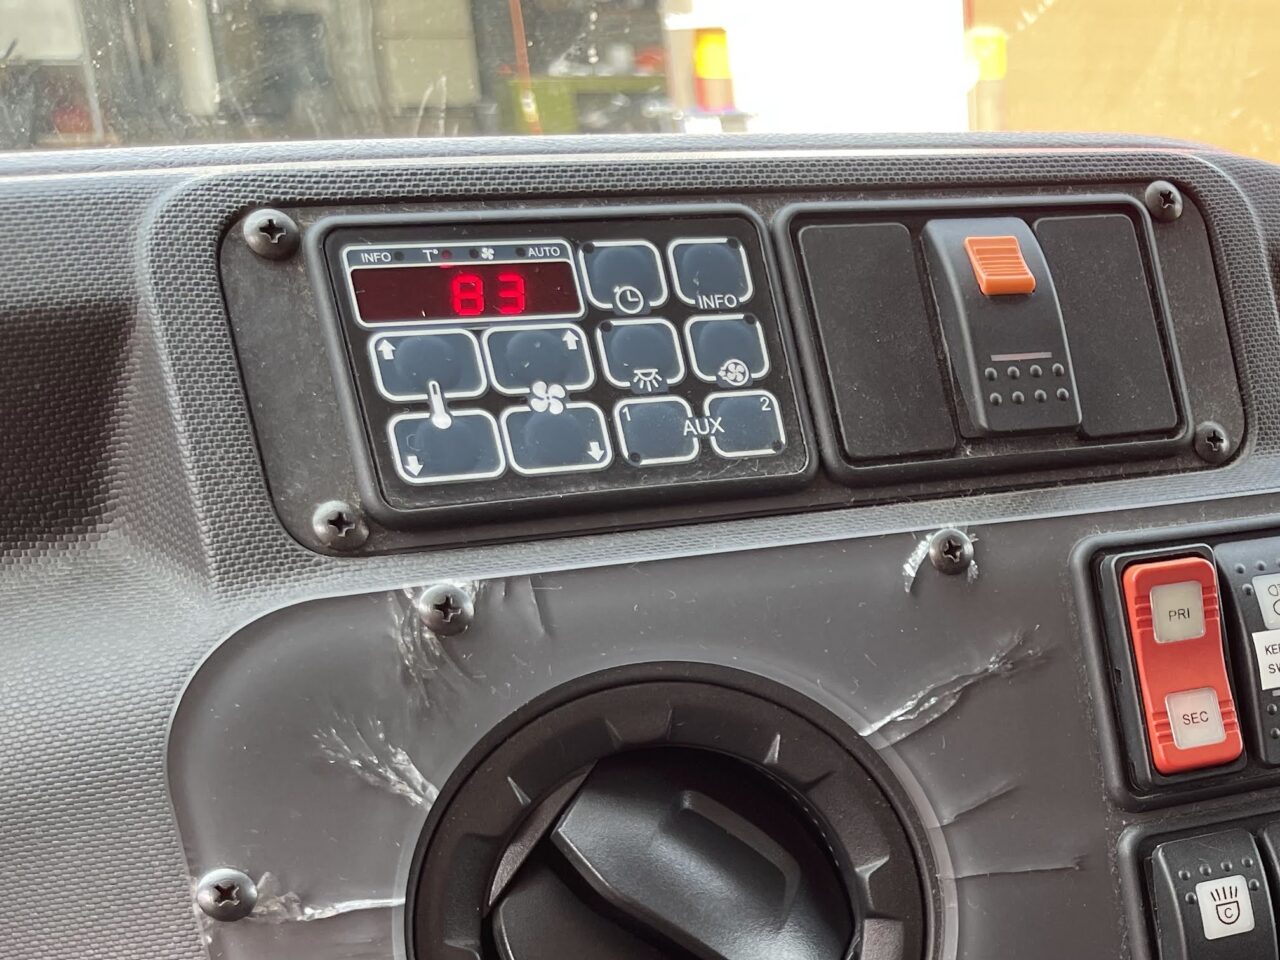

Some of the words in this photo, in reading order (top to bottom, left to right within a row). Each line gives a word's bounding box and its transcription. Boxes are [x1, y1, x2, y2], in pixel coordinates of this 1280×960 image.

[361, 252, 392, 264] INFO
[528, 247, 561, 258] AUTO
[451, 272, 526, 316] 83
[698, 294, 738, 309] INFO
[760, 397, 772, 411] 2
[622, 406, 632, 422] 1
[683, 417, 725, 436] AUX
[1168, 608, 1191, 622] PRI
[1182, 711, 1209, 726] SEC
[1224, 907, 1234, 919] C
